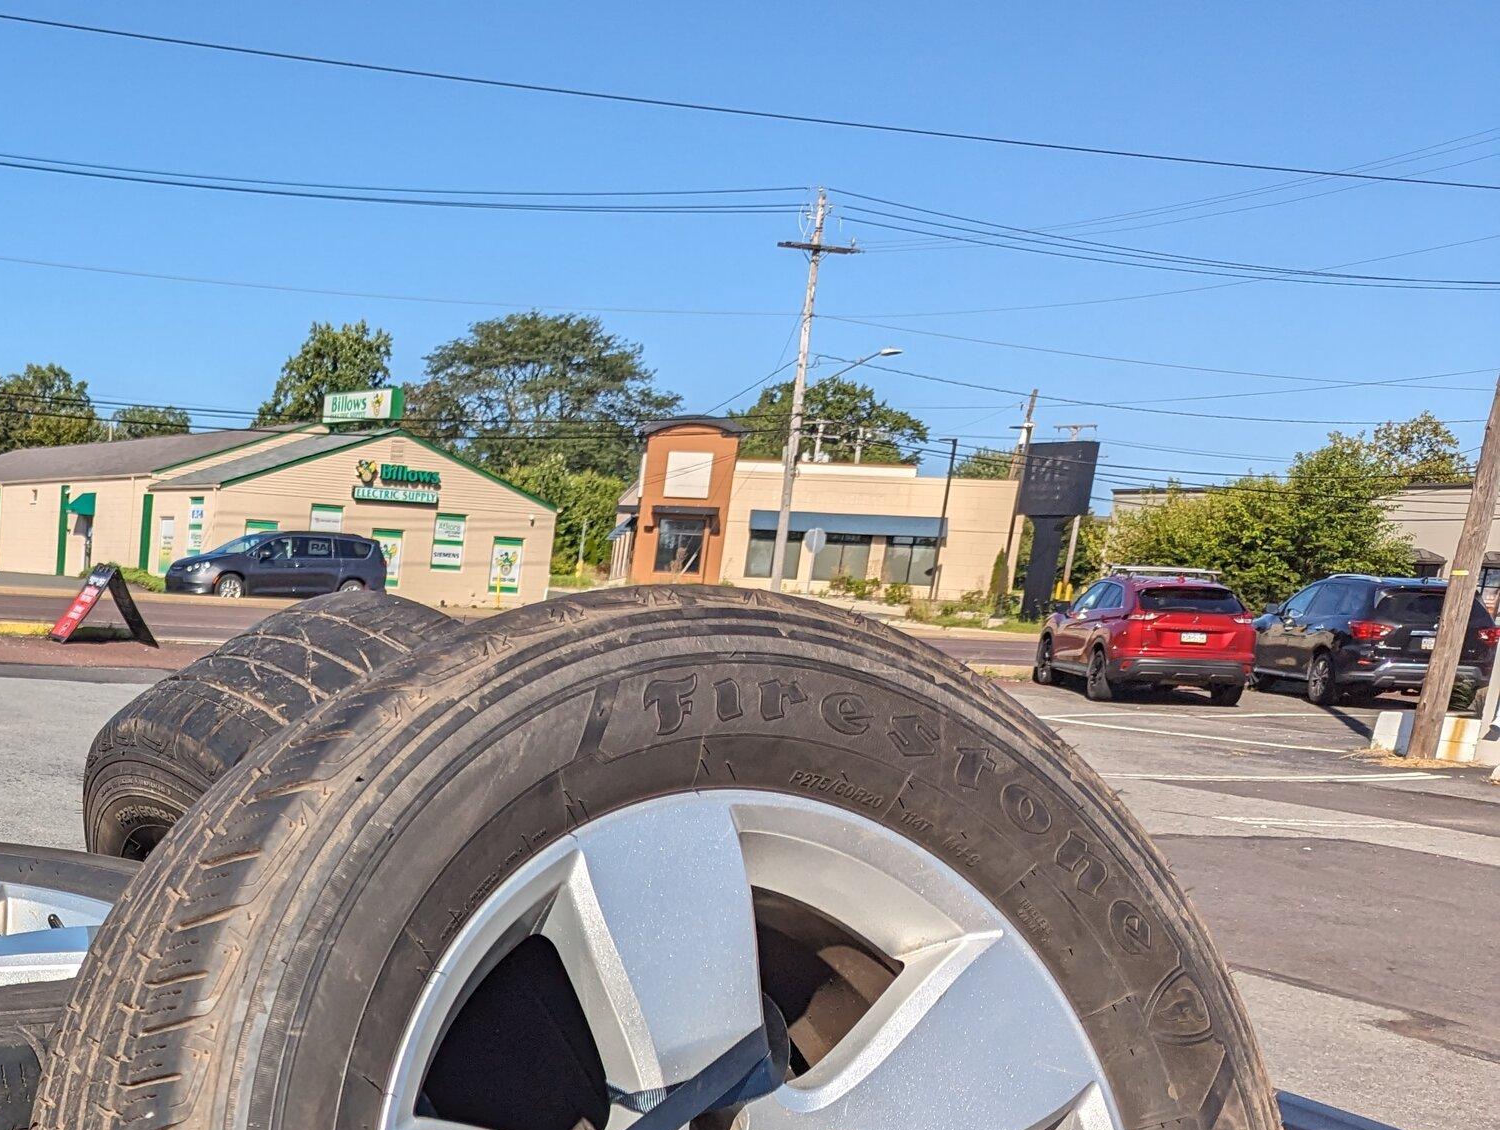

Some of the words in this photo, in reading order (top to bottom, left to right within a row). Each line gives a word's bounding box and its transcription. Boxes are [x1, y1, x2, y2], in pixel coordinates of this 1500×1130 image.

[331, 396, 367, 412] Billows
[380, 464, 440, 485] Billows
[356, 489, 399, 499] ELECTRIC
[403, 491, 436, 501] SUPPLY
[789, 769, 884, 809] P275/60R20
[899, 809, 935, 844] 114T
